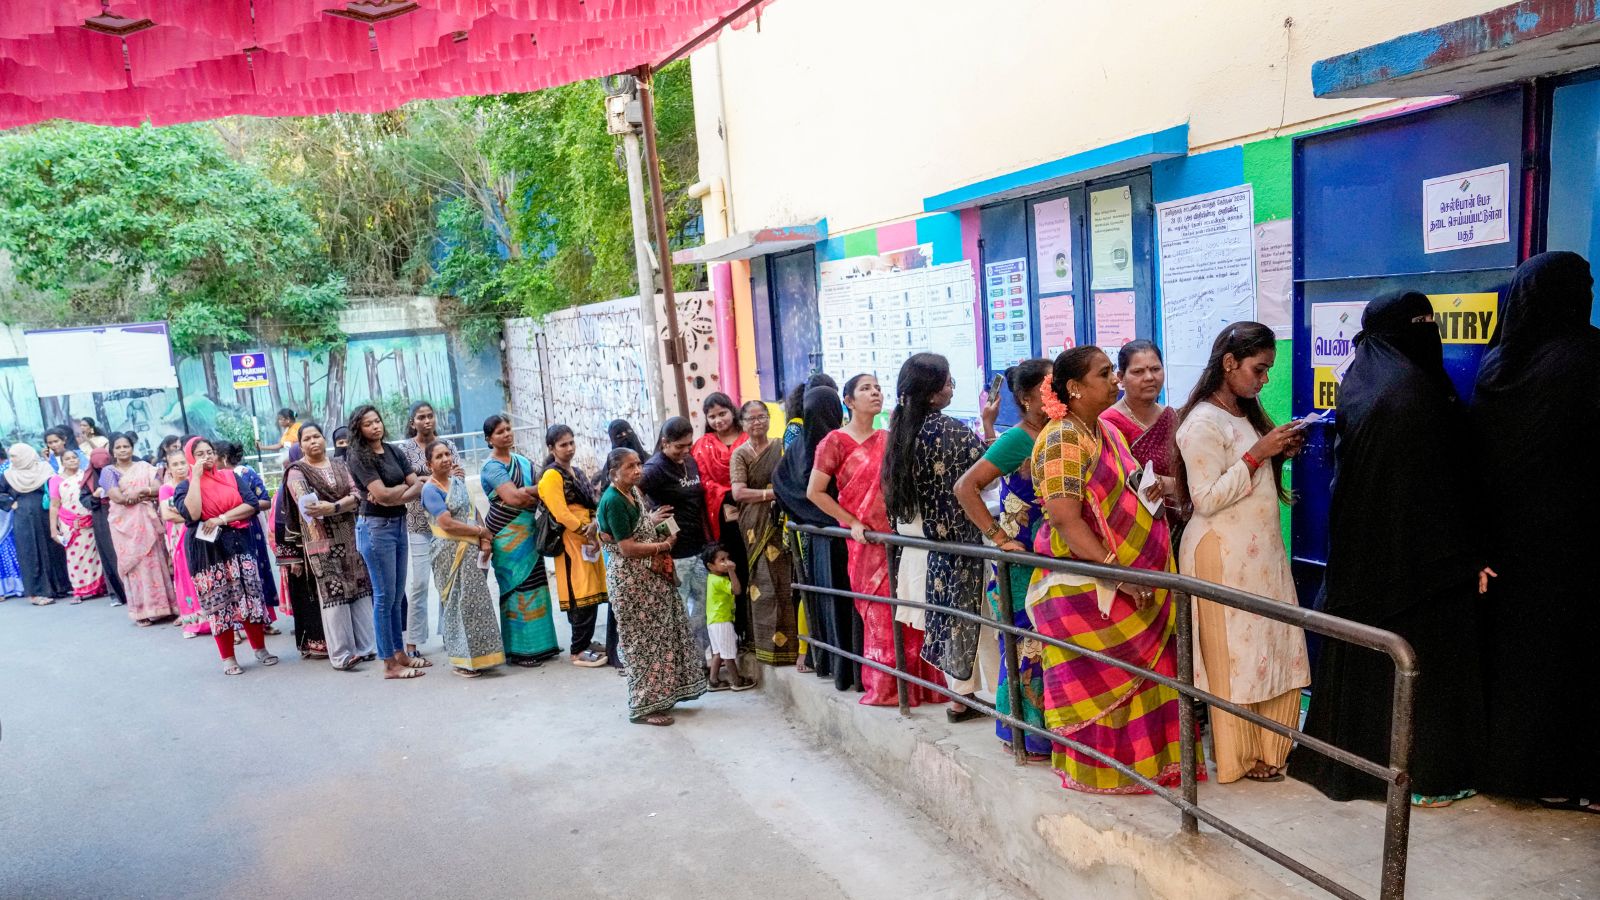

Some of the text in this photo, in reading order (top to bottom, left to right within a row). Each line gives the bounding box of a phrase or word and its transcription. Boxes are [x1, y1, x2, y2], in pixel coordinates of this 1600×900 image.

[1440, 194, 1492, 213] செல்போன் பேச
[1429, 206, 1503, 232] தடை செய்யப்பட்டுள்ள
[1457, 226, 1475, 242] பகுதி
[1434, 311, 1493, 339] NTRY
[1315, 331, 1356, 356] பெண்
[242, 367, 265, 375] PARKING
